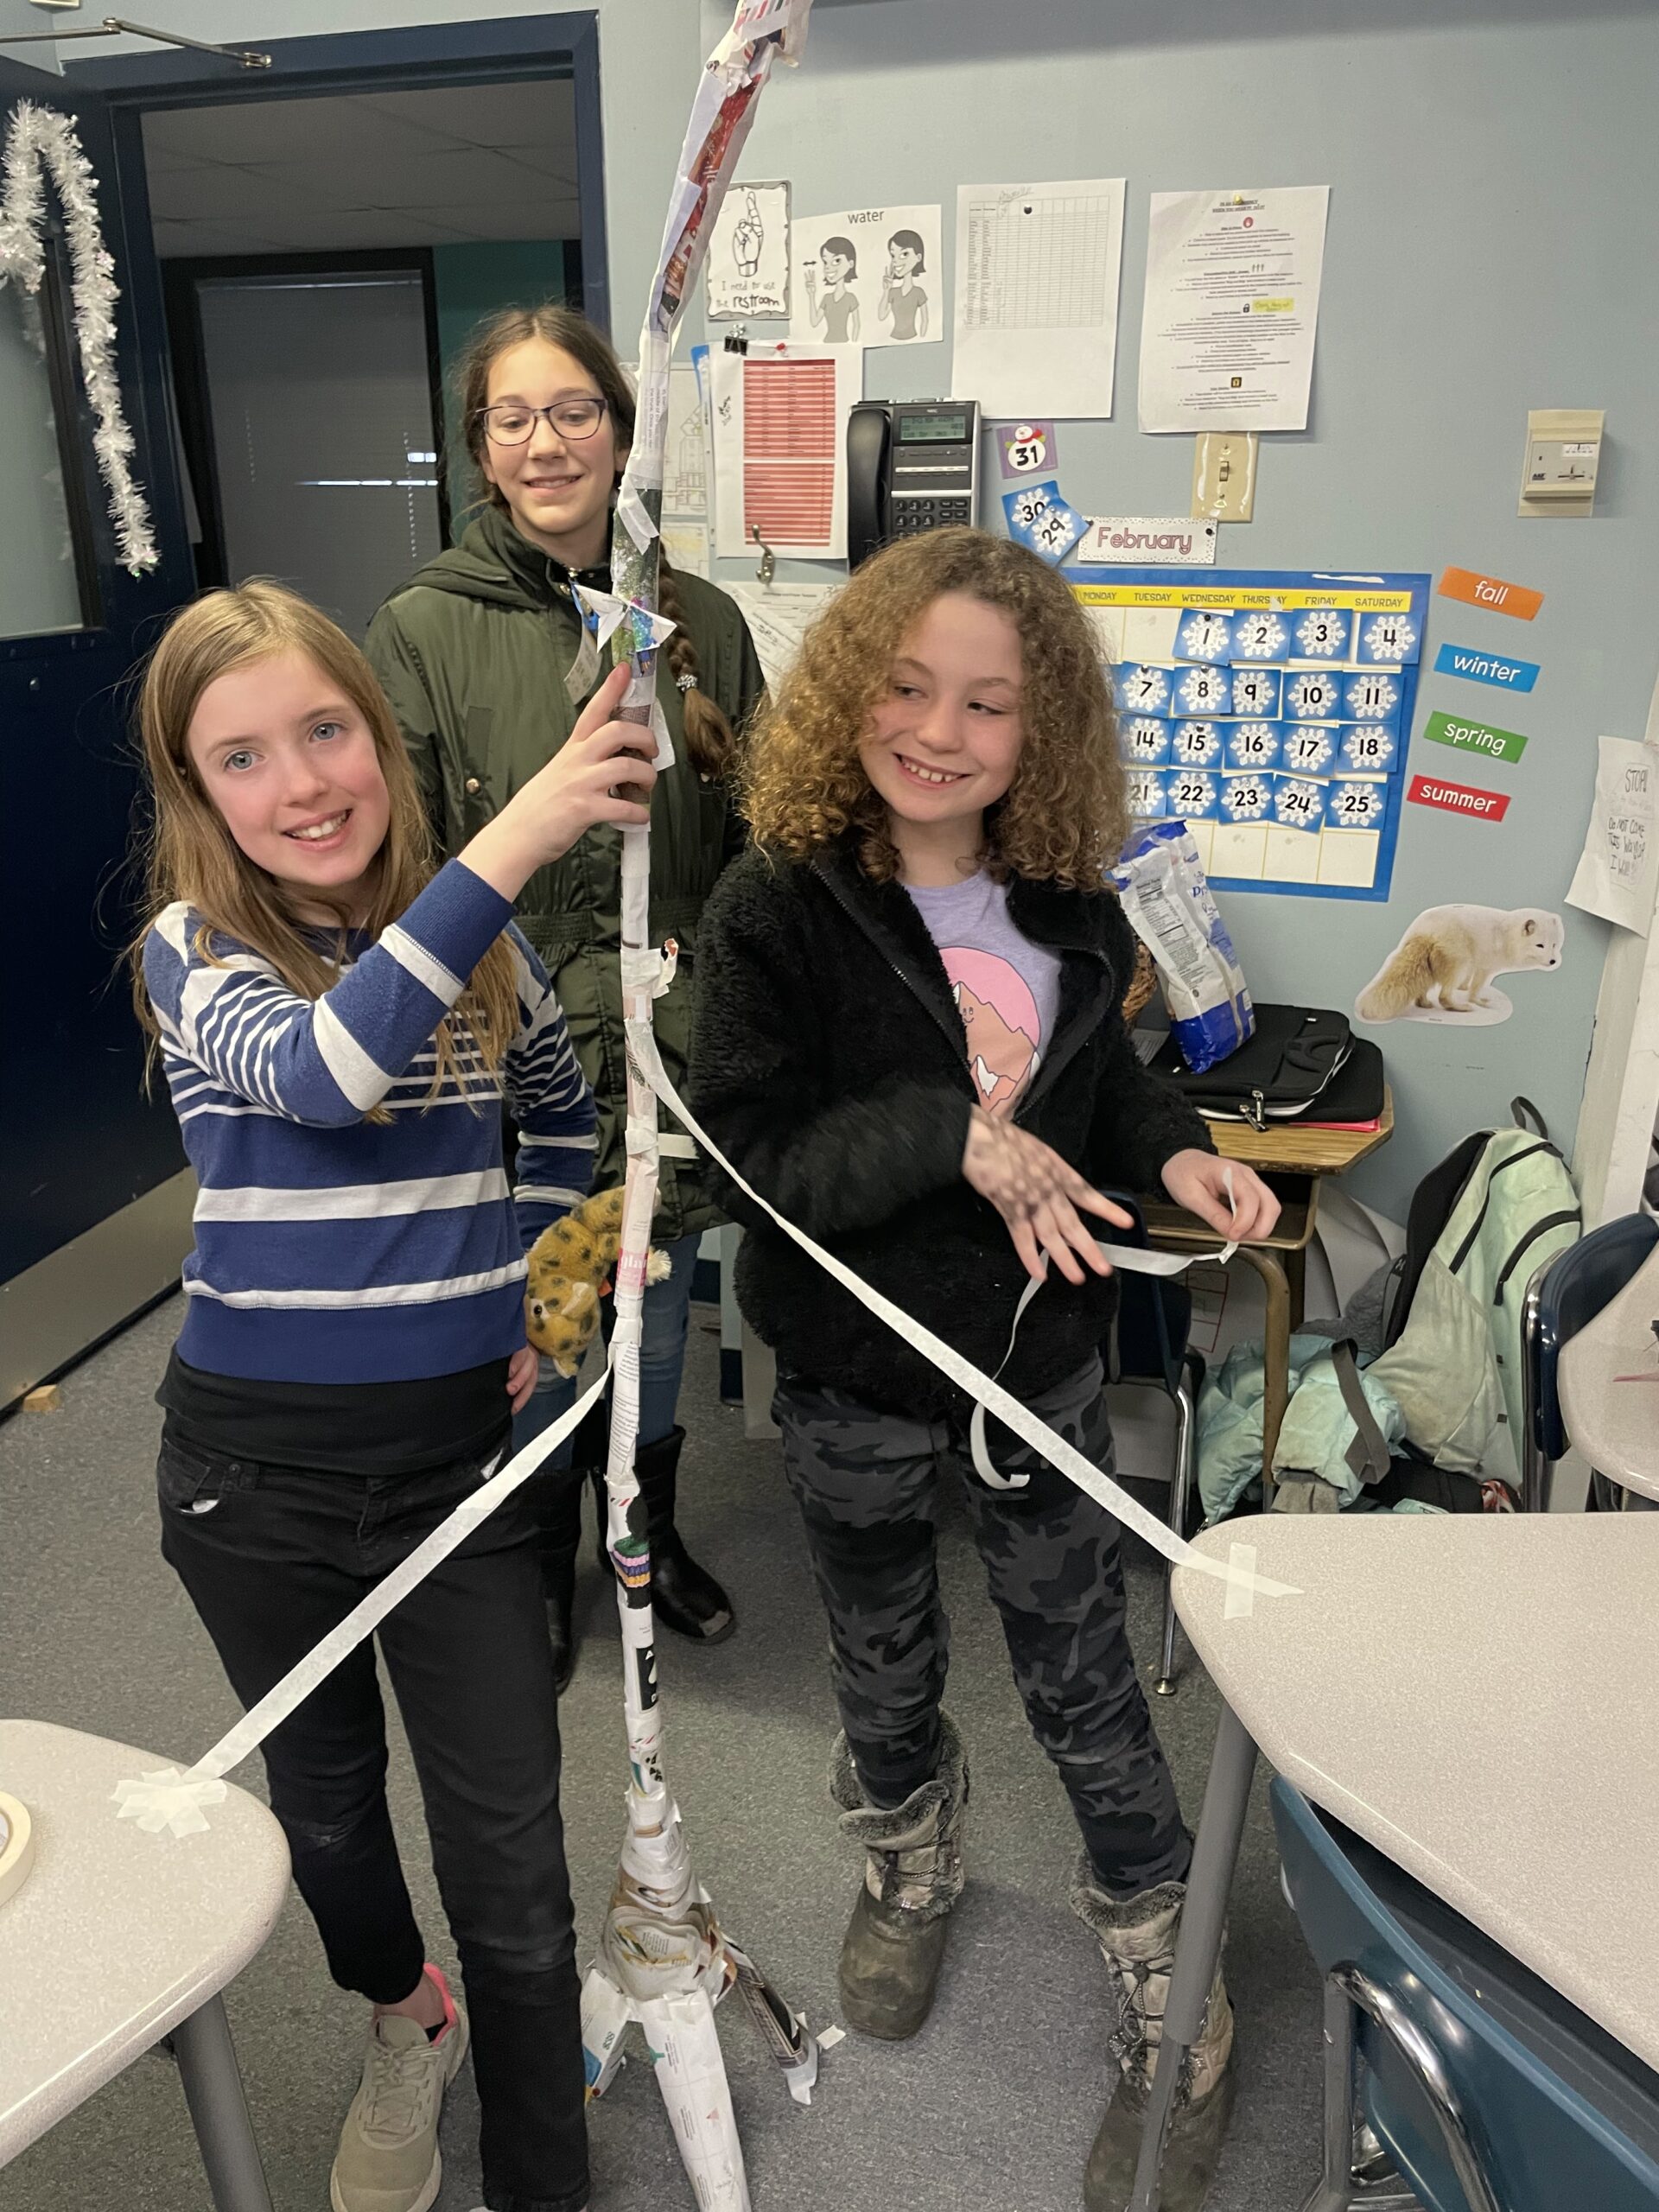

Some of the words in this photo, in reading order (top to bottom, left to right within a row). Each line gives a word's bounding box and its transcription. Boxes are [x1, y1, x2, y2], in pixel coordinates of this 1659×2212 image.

[848, 211, 885, 224] water
[721, 280, 727, 291] I
[730, 281, 747, 290] need
[733, 294, 780, 308] restroom
[1015, 445, 1038, 467] 31
[1022, 501, 1045, 523] 30
[1042, 518, 1065, 545] 29
[1097, 526, 1192, 555] February
[1083, 592, 1117, 601] MONDAY
[1135, 592, 1173, 601] TUESDAY
[1181, 594, 1236, 603] WEDNESDAY
[1242, 595, 1287, 604] THURSAY
[1305, 596, 1338, 605] FRIDAY
[1354, 598, 1404, 607] SATURDAY
[1473, 581, 1508, 606] fall
[1203, 628, 1210, 645] 1
[1255, 626, 1268, 644] 2
[1315, 624, 1327, 642] 3
[1383, 629, 1396, 646] 4
[1453, 654, 1521, 683] winter
[1140, 681, 1153, 697] 7
[1197, 681, 1209, 697] 8
[1244, 683, 1256, 701] 9
[1303, 687, 1322, 704] 10
[1365, 688, 1380, 705] 11
[1136, 730, 1154, 747] 14
[1187, 734, 1205, 751] 15
[1245, 735, 1263, 753] 16
[1299, 740, 1319, 757] 17
[1359, 739, 1378, 755] 18
[1444, 721, 1507, 755] spring
[1130, 785, 1148, 801] 21
[1179, 785, 1204, 802] 22
[1234, 789, 1258, 807] 23
[1285, 793, 1310, 813] 24
[1344, 795, 1369, 812] 25
[1420, 784, 1497, 813] summer
[1611, 854, 1618, 869] I
